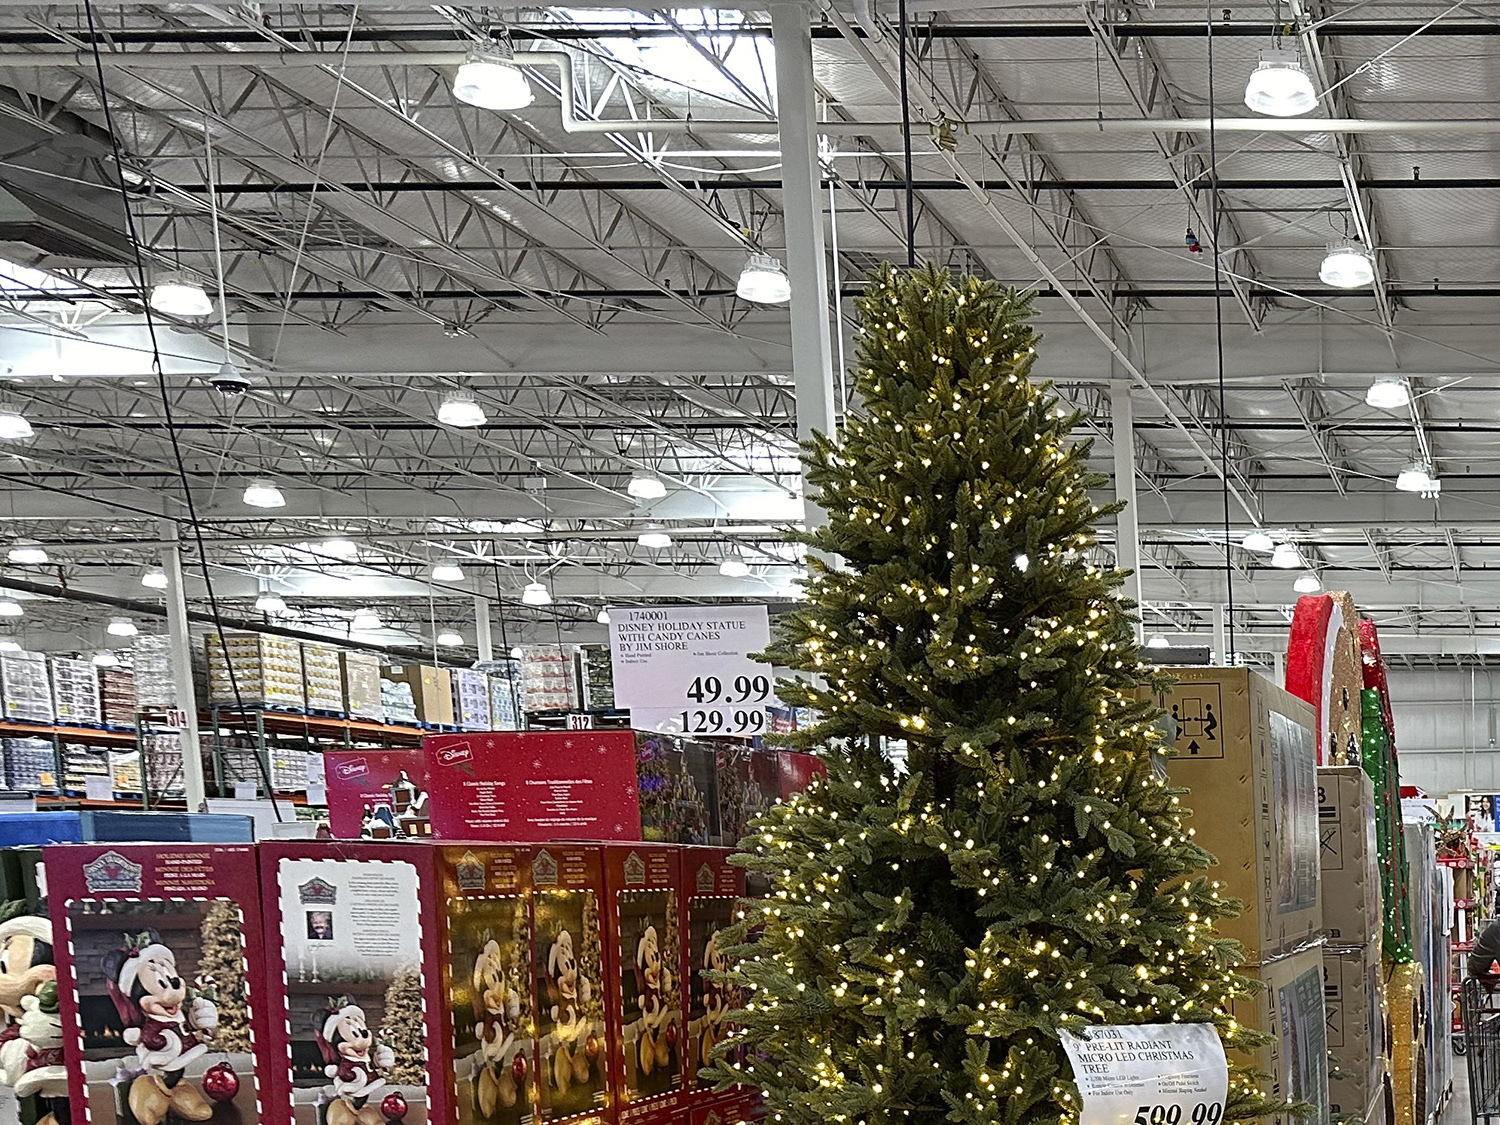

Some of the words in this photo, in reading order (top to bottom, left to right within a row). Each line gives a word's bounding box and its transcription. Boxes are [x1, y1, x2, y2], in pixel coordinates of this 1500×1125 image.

[628, 610, 668, 620] 1740001
[618, 622, 654, 632] DISNEY
[657, 621, 702, 631] HOLIDAY
[706, 620, 746, 630] STATUE
[618, 632, 645, 642] WITH
[648, 632, 684, 642] CANDY
[686, 631, 720, 640] CANES
[620, 642, 634, 652] BY
[635, 642, 652, 652] JIM
[654, 642, 688, 650] SHORE
[686, 674, 770, 704] 49.99
[168, 710, 188, 728] 314
[572, 716, 590, 729] 312
[680, 709, 764, 733] 129.99
[444, 749, 470, 761] Disney
[338, 764, 366, 776] Disney
[1085, 1041, 1125, 1052] PRE-LIT
[1127, 1040, 1172, 1050] RADIANT
[1077, 1052, 1113, 1063] MICRO
[1114, 1052, 1136, 1062] LED
[1138, 1050, 1194, 1062] CHRISTMAS
[1082, 1064, 1110, 1074] TREE
